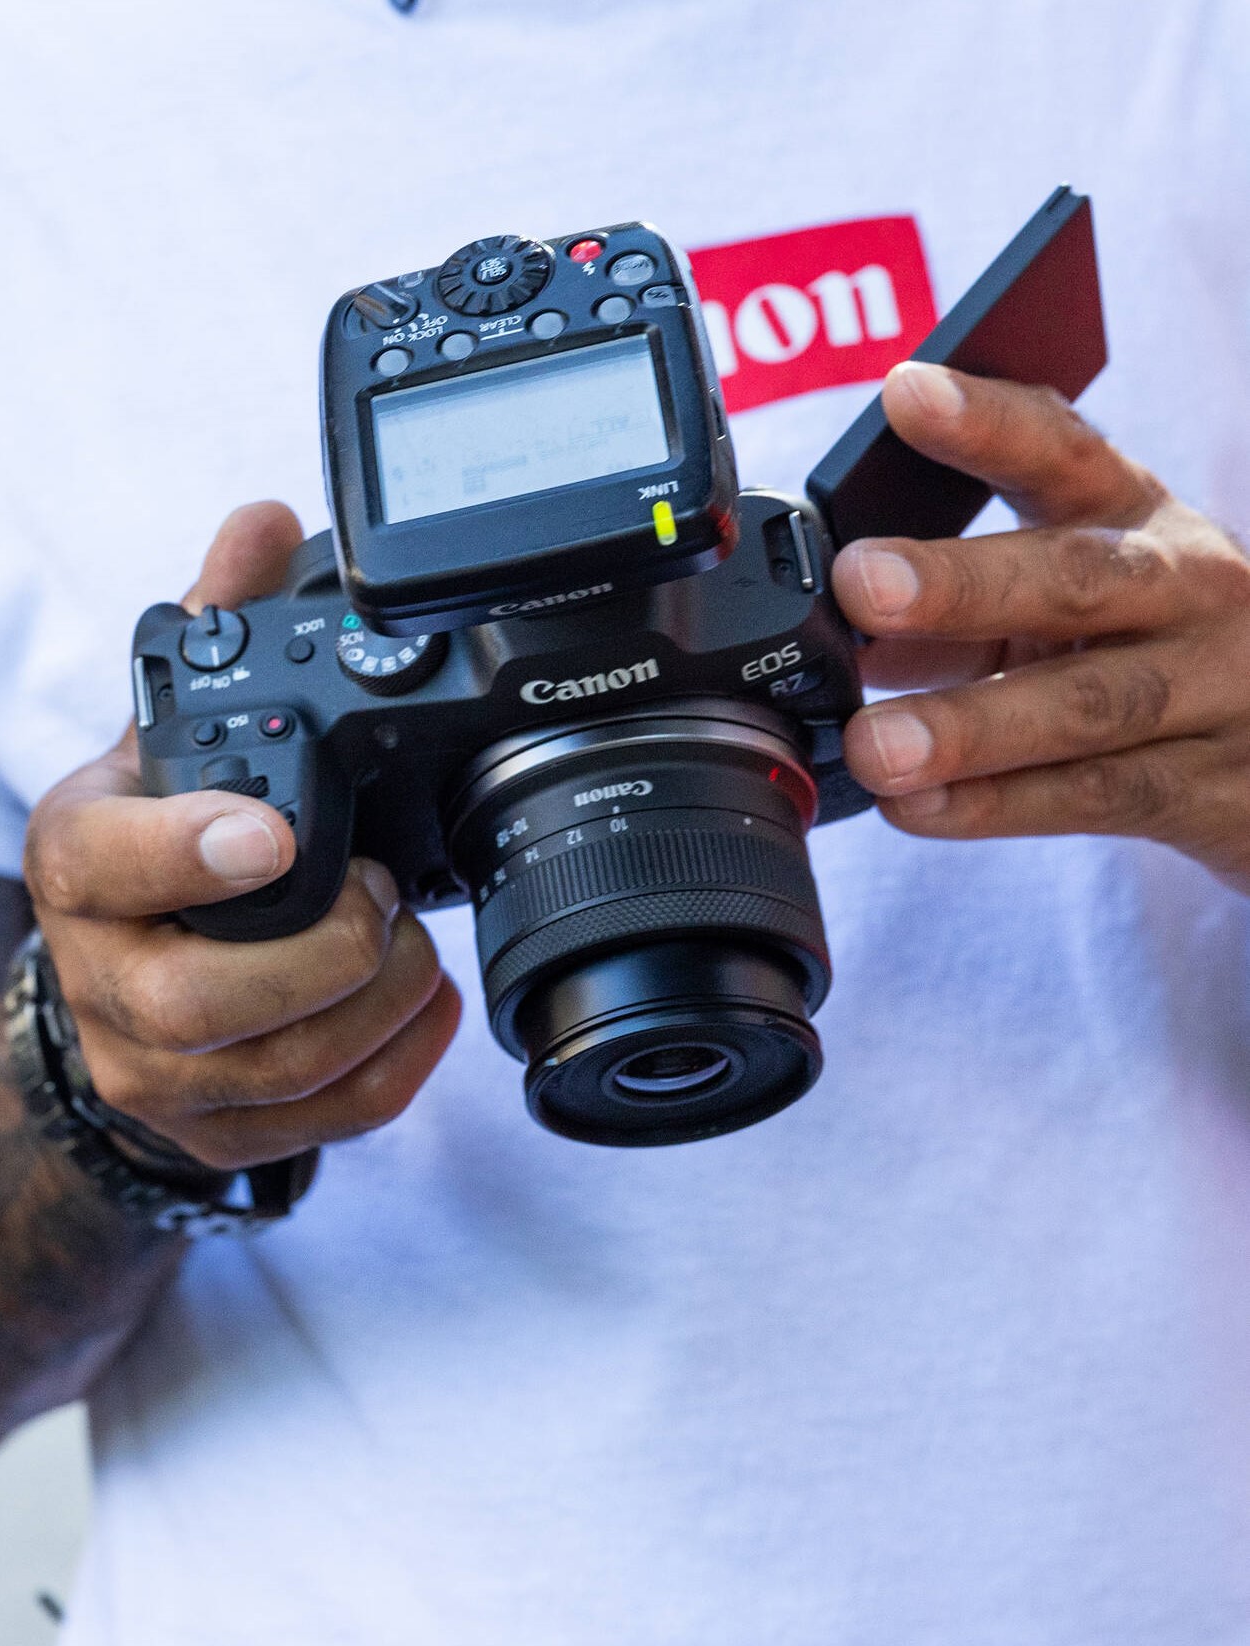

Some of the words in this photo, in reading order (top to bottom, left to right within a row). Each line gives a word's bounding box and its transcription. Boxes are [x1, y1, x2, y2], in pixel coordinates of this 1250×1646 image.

[421, 315, 449, 329] OFF
[479, 315, 522, 333] CLEAR
[382, 332, 406, 346] ON
[407, 325, 444, 343] LOCK
[637, 480, 680, 500] LINK
[489, 582, 613, 617] Canon
[293, 617, 326, 636] LOCK
[741, 641, 803, 682] EOS
[519, 657, 661, 705] Canon
[769, 672, 806, 698] R7
[226, 714, 249, 728] ISO
[573, 780, 654, 807] Canon
[610, 817, 629, 833] 10
[565, 829, 584, 845] 12
[524, 847, 540, 864] 14
